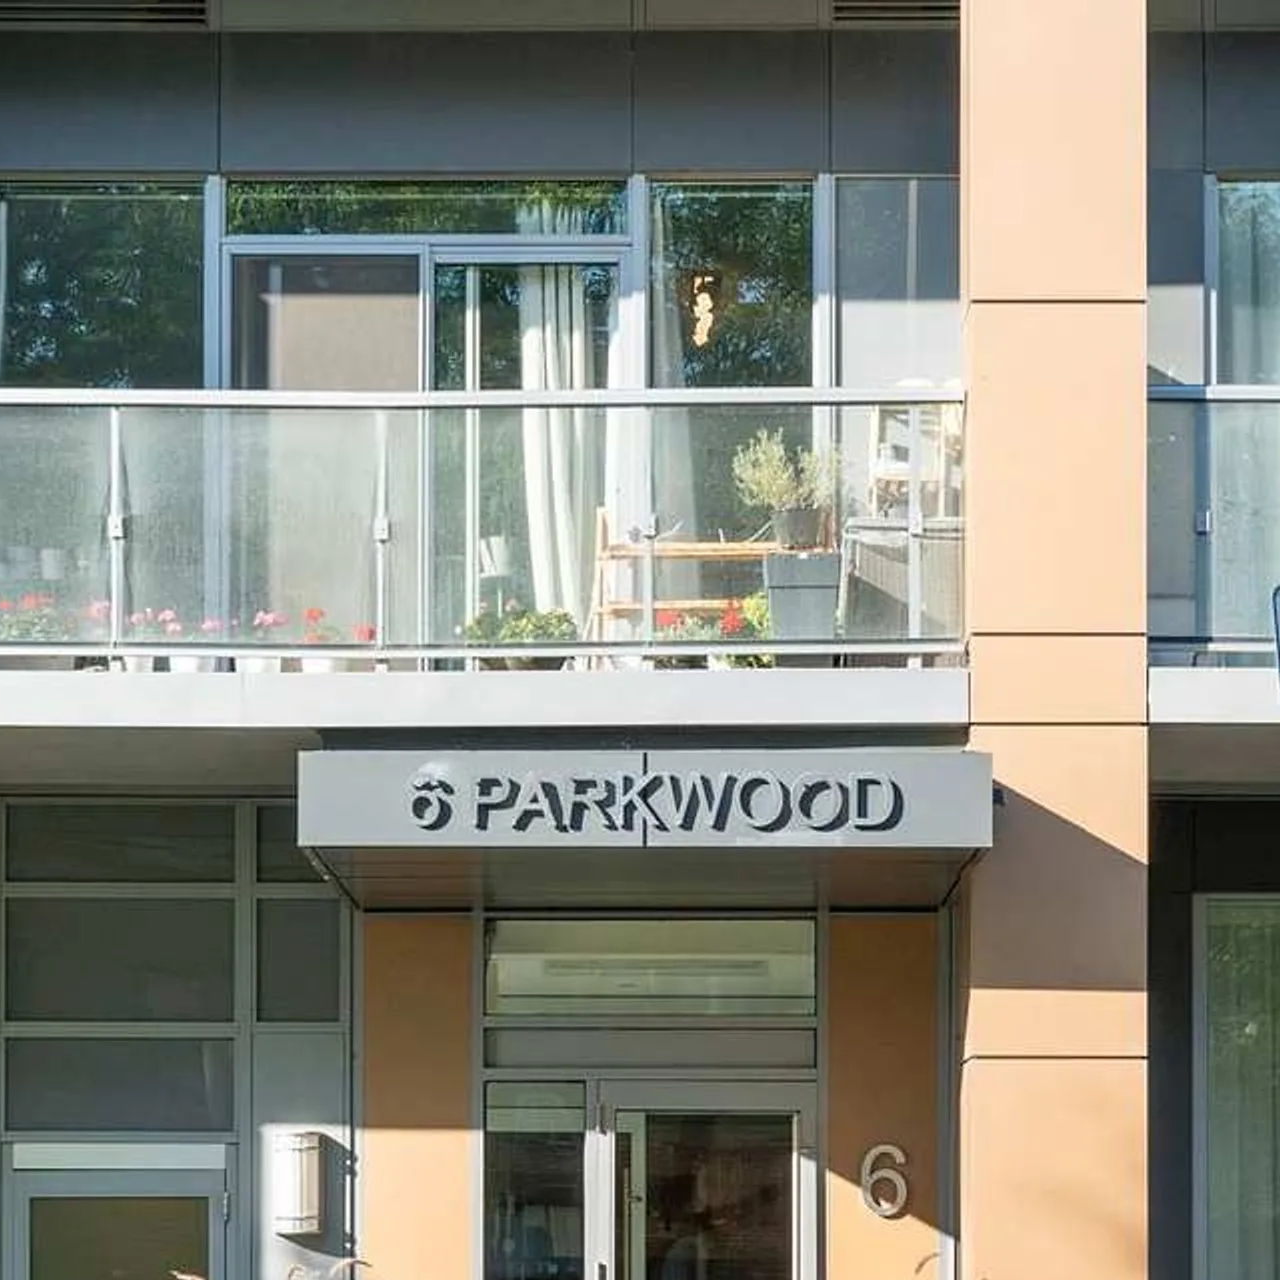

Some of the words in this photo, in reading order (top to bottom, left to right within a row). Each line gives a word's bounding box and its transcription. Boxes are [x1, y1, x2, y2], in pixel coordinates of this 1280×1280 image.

[411, 771, 456, 832] 6
[474, 772, 906, 833] PARKWOOD
[862, 1144, 907, 1217] 6
